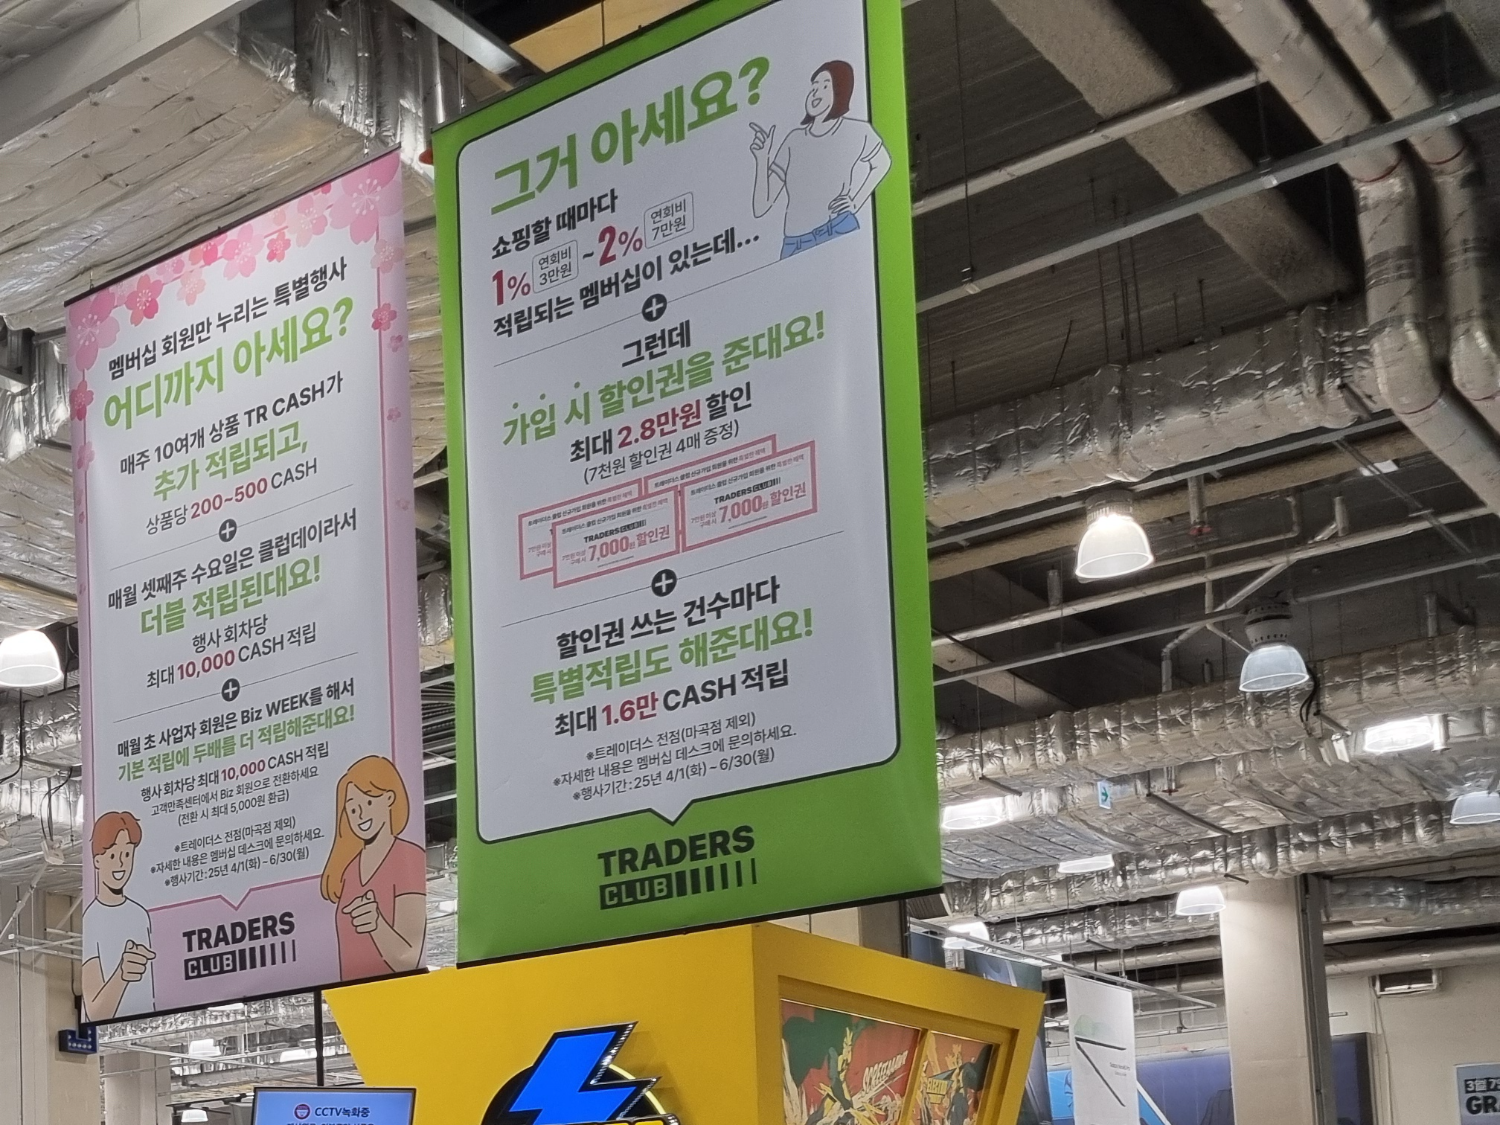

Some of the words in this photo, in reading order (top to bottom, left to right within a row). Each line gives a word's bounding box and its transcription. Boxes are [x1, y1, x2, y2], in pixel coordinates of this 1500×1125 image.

[491, 132, 578, 215] 그거
[590, 56, 769, 165] 아세요?
[491, 216, 552, 259] 쇼핑할
[555, 189, 618, 231] 때마다
[649, 198, 686, 225] 연회비
[651, 214, 686, 241] 7만원
[538, 246, 571, 271] 연회비
[539, 261, 575, 286] 3만원
[598, 225, 643, 267] 2%
[492, 265, 533, 306] 1%
[493, 295, 575, 337] 적립되는
[579, 256, 662, 310] 멤버십이
[108, 340, 156, 381] 멤버십
[161, 316, 212, 356] 회원만
[216, 296, 269, 333] 누리는
[273, 258, 347, 306] 특별행사
[621, 319, 691, 367] 그런데
[102, 346, 223, 431] 어디까지
[233, 296, 353, 376] 아세요?
[503, 403, 556, 446] 가입
[564, 391, 590, 425] 시
[597, 351, 715, 417] 할인권을
[721, 310, 824, 376] 준대요!
[120, 449, 151, 475] 매주
[154, 426, 205, 463] 10여개
[209, 413, 240, 443] 상품
[243, 404, 268, 427] TR
[272, 371, 343, 417] CASH가
[570, 428, 613, 462] 최대
[617, 399, 702, 449] 2.8만원
[705, 381, 752, 421] 할인
[153, 458, 199, 502] 추가
[205, 420, 308, 480] 적립되고,
[583, 456, 626, 485] (7천원
[628, 441, 672, 470] 할인권
[675, 431, 700, 453] 4매
[703, 419, 739, 446] 증정)
[146, 504, 188, 535] 상품당
[270, 457, 317, 489] CASH
[769, 482, 806, 507] 할인권
[108, 583, 137, 610] 매월
[141, 568, 187, 601] 셋째주
[190, 546, 254, 584] 수요일은
[258, 507, 356, 563] 클럽데이라서
[141, 597, 187, 635] 더블
[192, 628, 222, 654] 행사
[223, 614, 268, 643] 회차당
[556, 617, 625, 660] 할인권
[630, 608, 677, 639] 쓰는
[683, 575, 780, 627] 건수마다
[146, 664, 174, 688] 최대
[177, 649, 235, 680] 10,000
[238, 633, 284, 662] CASH
[287, 621, 316, 647] 적립
[530, 644, 672, 703] 특별적립도
[678, 607, 813, 667] 해준대요!
[554, 705, 597, 736] 최대
[601, 691, 659, 726] 1.6만
[662, 673, 736, 711] CASH
[741, 658, 788, 692] 적립
[597, 825, 755, 877] TRADERS
[604, 877, 667, 906] CLUB
[182, 911, 295, 953] TRADERS
[187, 953, 233, 977] CLUB
[314, 1107, 370, 1118] CCTV녹화중
[1465, 1094, 1500, 1115] GR
